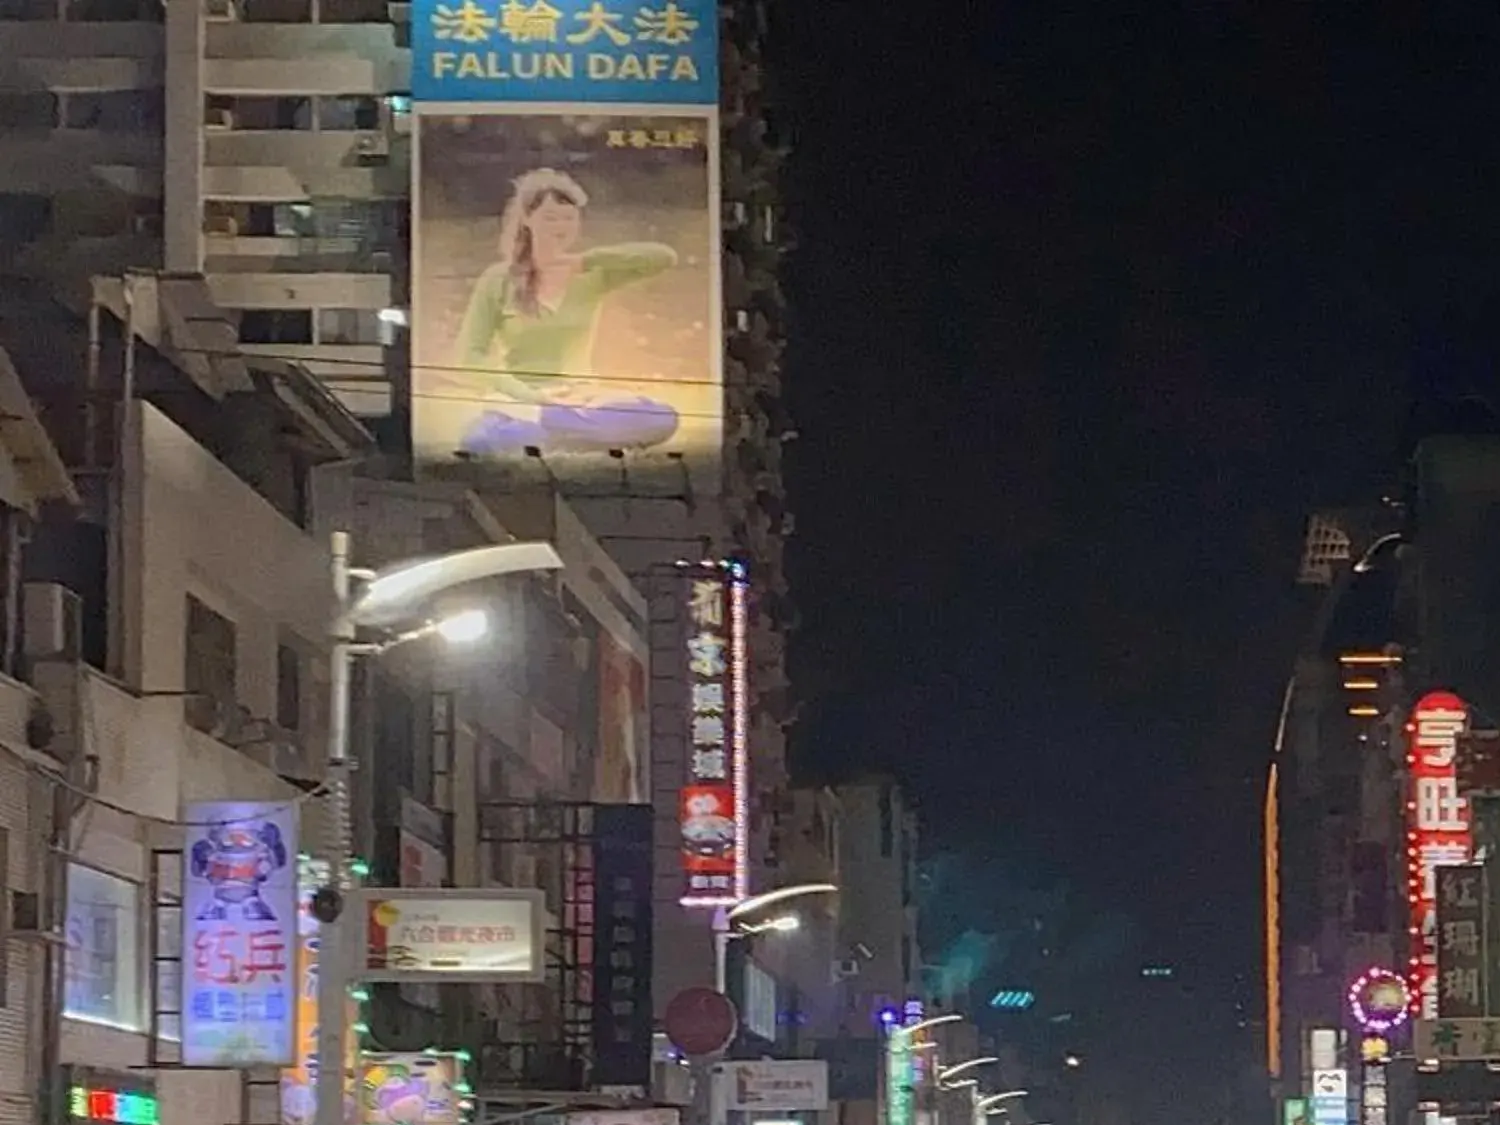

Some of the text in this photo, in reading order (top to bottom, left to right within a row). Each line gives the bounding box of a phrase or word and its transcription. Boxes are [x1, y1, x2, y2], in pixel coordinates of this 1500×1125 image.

[431, 1, 699, 48] 法輪大法
[432, 52, 698, 82] FALUN DAFA
